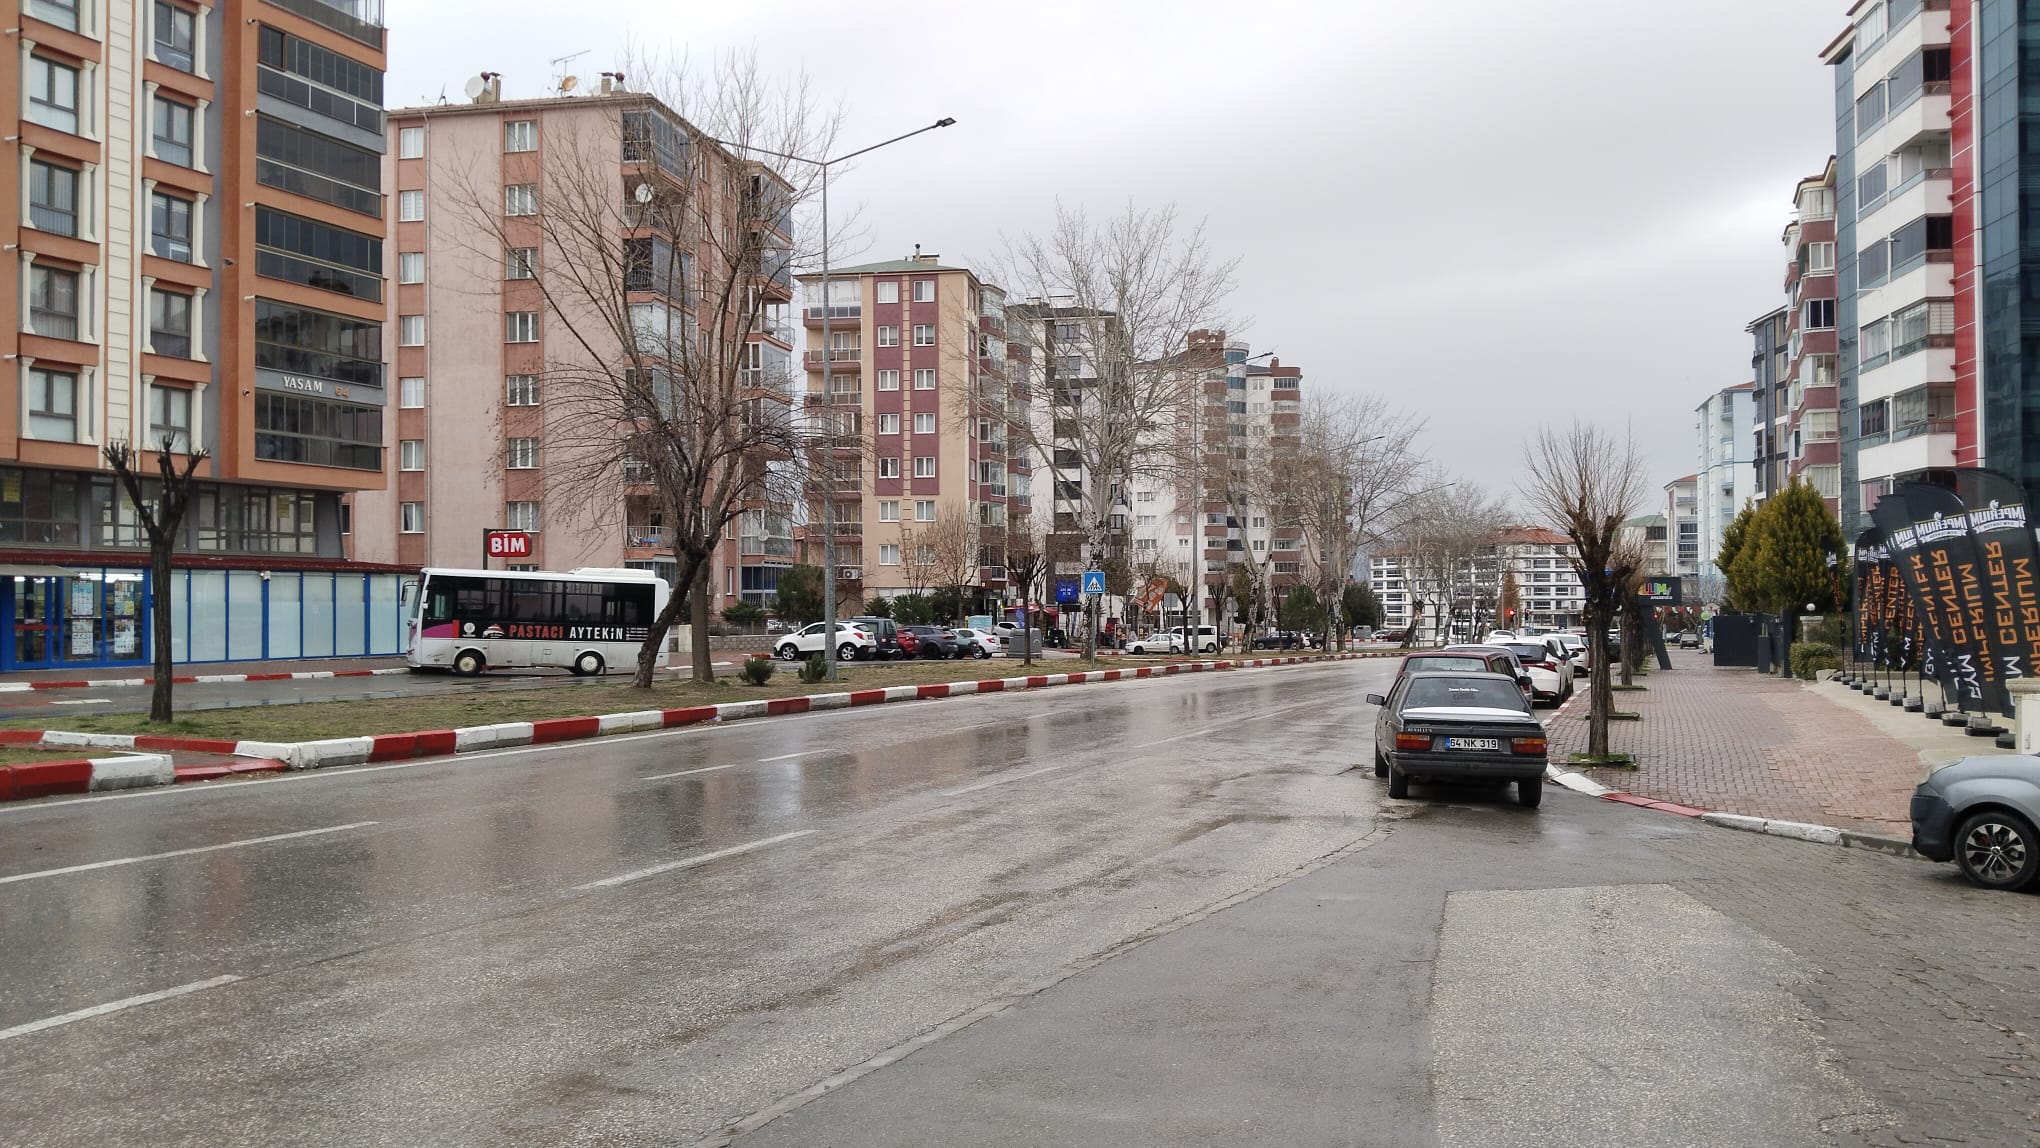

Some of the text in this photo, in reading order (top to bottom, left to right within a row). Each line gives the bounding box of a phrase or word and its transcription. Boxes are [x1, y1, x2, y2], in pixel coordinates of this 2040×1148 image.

[491, 534, 526, 553] BİM
[509, 624, 564, 639] PASTACI
[1450, 739, 1461, 748] 64
[1464, 739, 1477, 748] NK
[1480, 739, 1497, 749] 319
